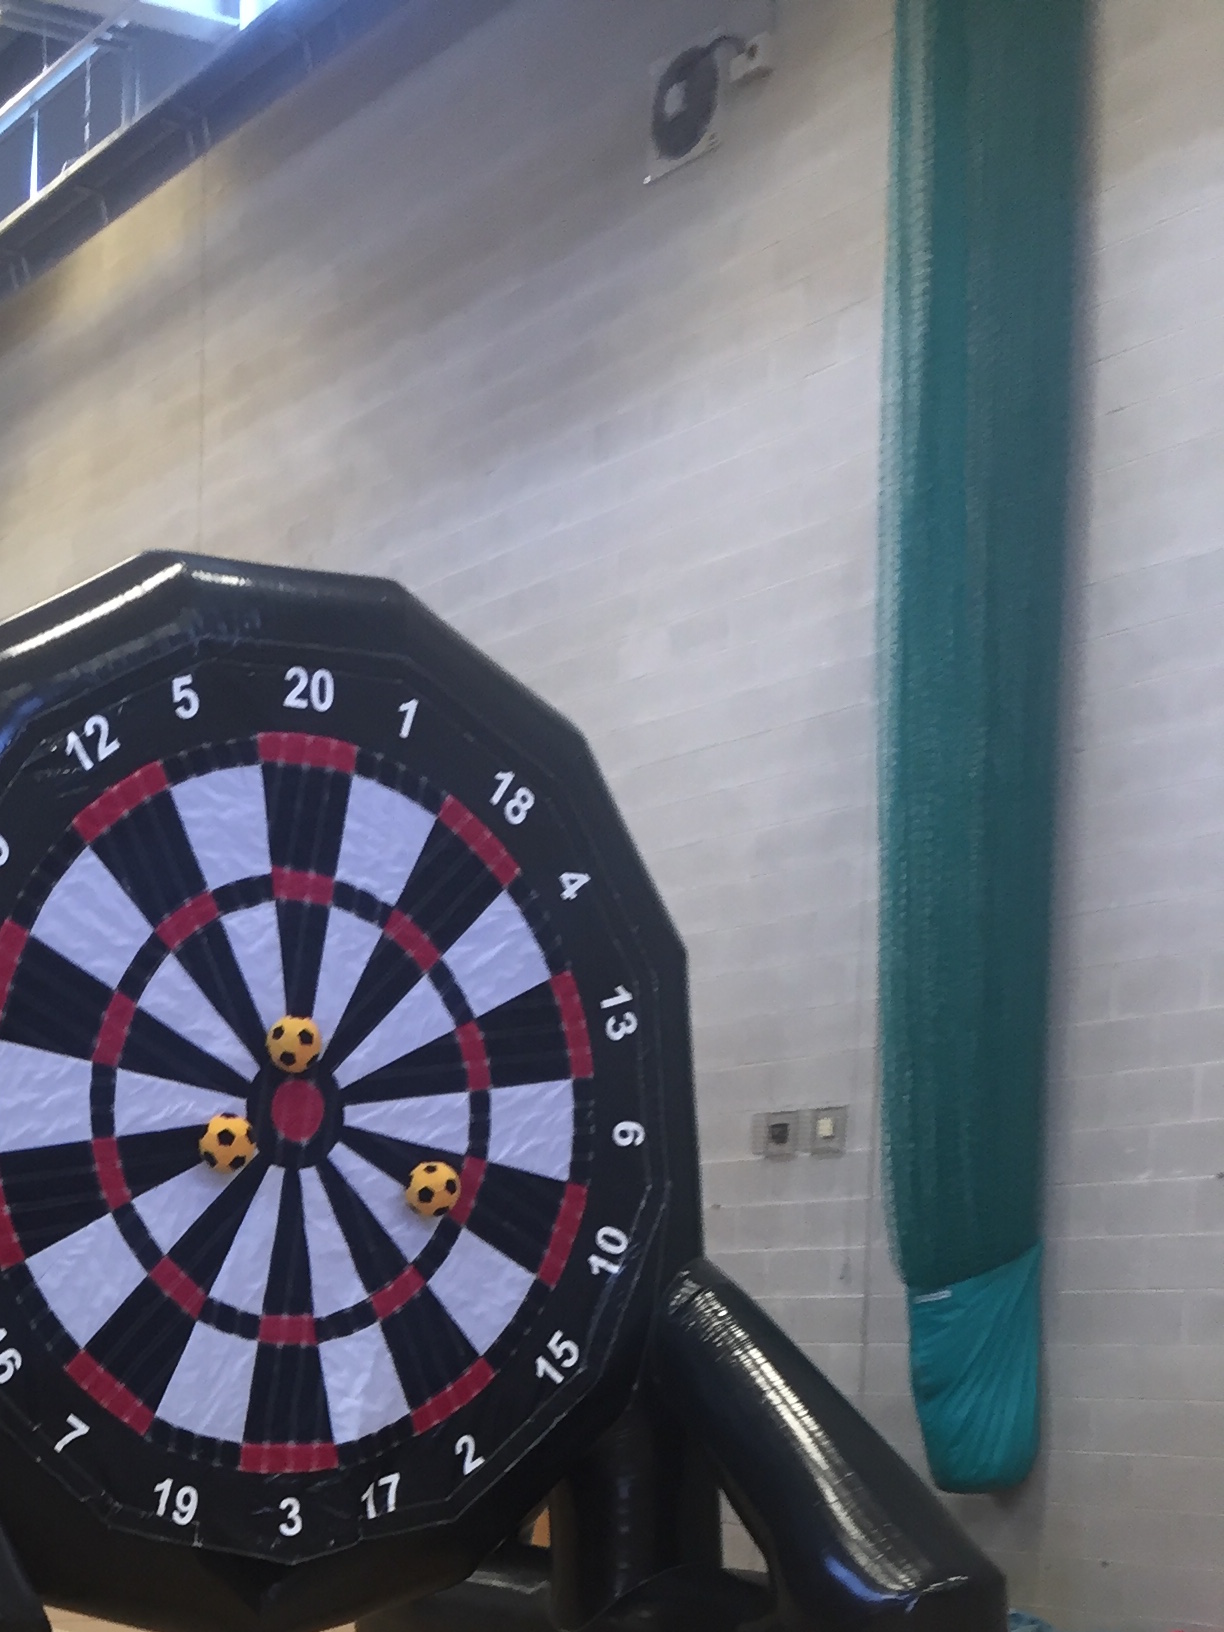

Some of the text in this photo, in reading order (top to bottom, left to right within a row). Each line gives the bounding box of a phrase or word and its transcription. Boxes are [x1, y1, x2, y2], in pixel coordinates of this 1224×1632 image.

[171, 673, 200, 720] 5
[282, 666, 335, 713] 20
[398, 698, 419, 739] 1
[65, 714, 121, 771] 12
[489, 770, 535, 825] 18
[558, 871, 592, 900] 4
[600, 985, 638, 1041] 13
[587, 1225, 629, 1275] 10
[535, 1329, 579, 1384] 15
[53, 1413, 90, 1453] 7
[455, 1434, 486, 1476] 2
[154, 1477, 199, 1526] 19
[279, 1497, 303, 1537] 3
[361, 1472, 401, 1520] 17
